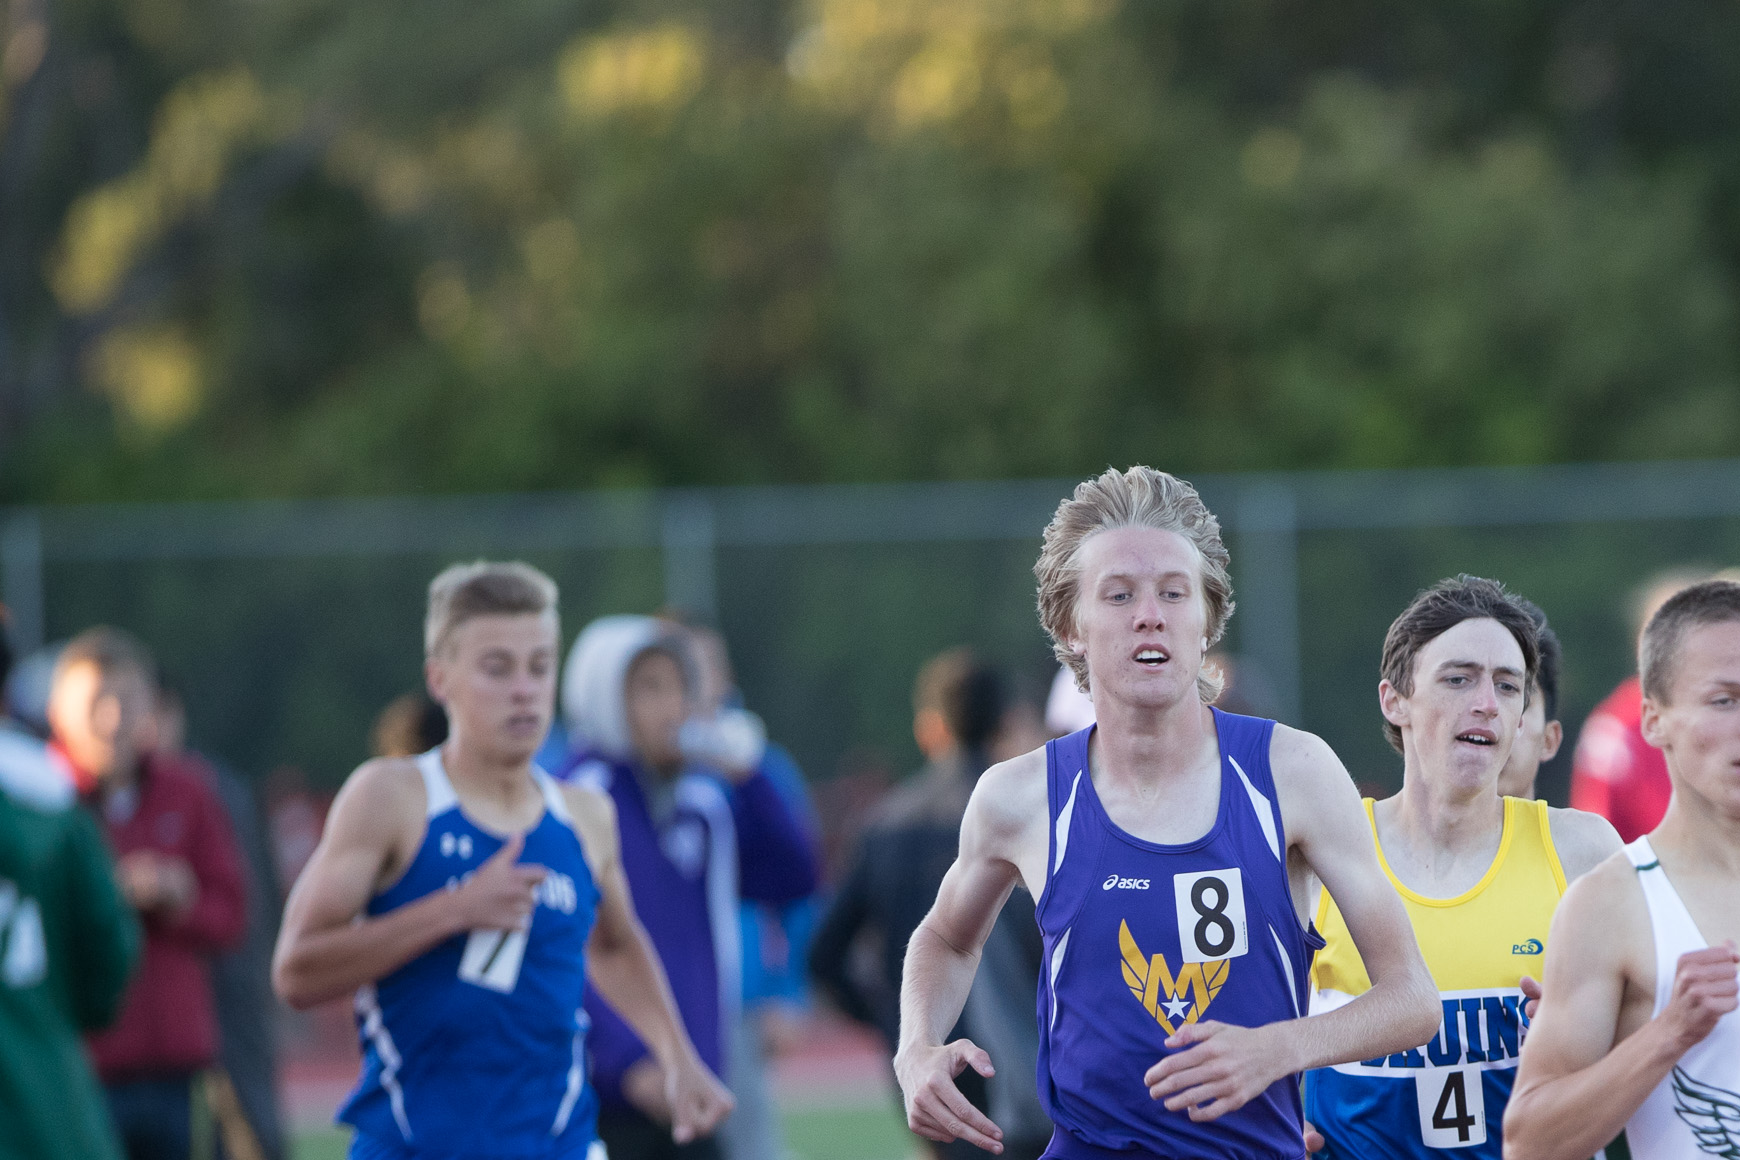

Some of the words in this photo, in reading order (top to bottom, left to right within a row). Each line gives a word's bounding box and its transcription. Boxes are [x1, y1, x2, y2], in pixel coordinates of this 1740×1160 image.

[1117, 878, 1150, 890] asics
[1190, 876, 1235, 957] 8
[1432, 1070, 1475, 1142] 4
